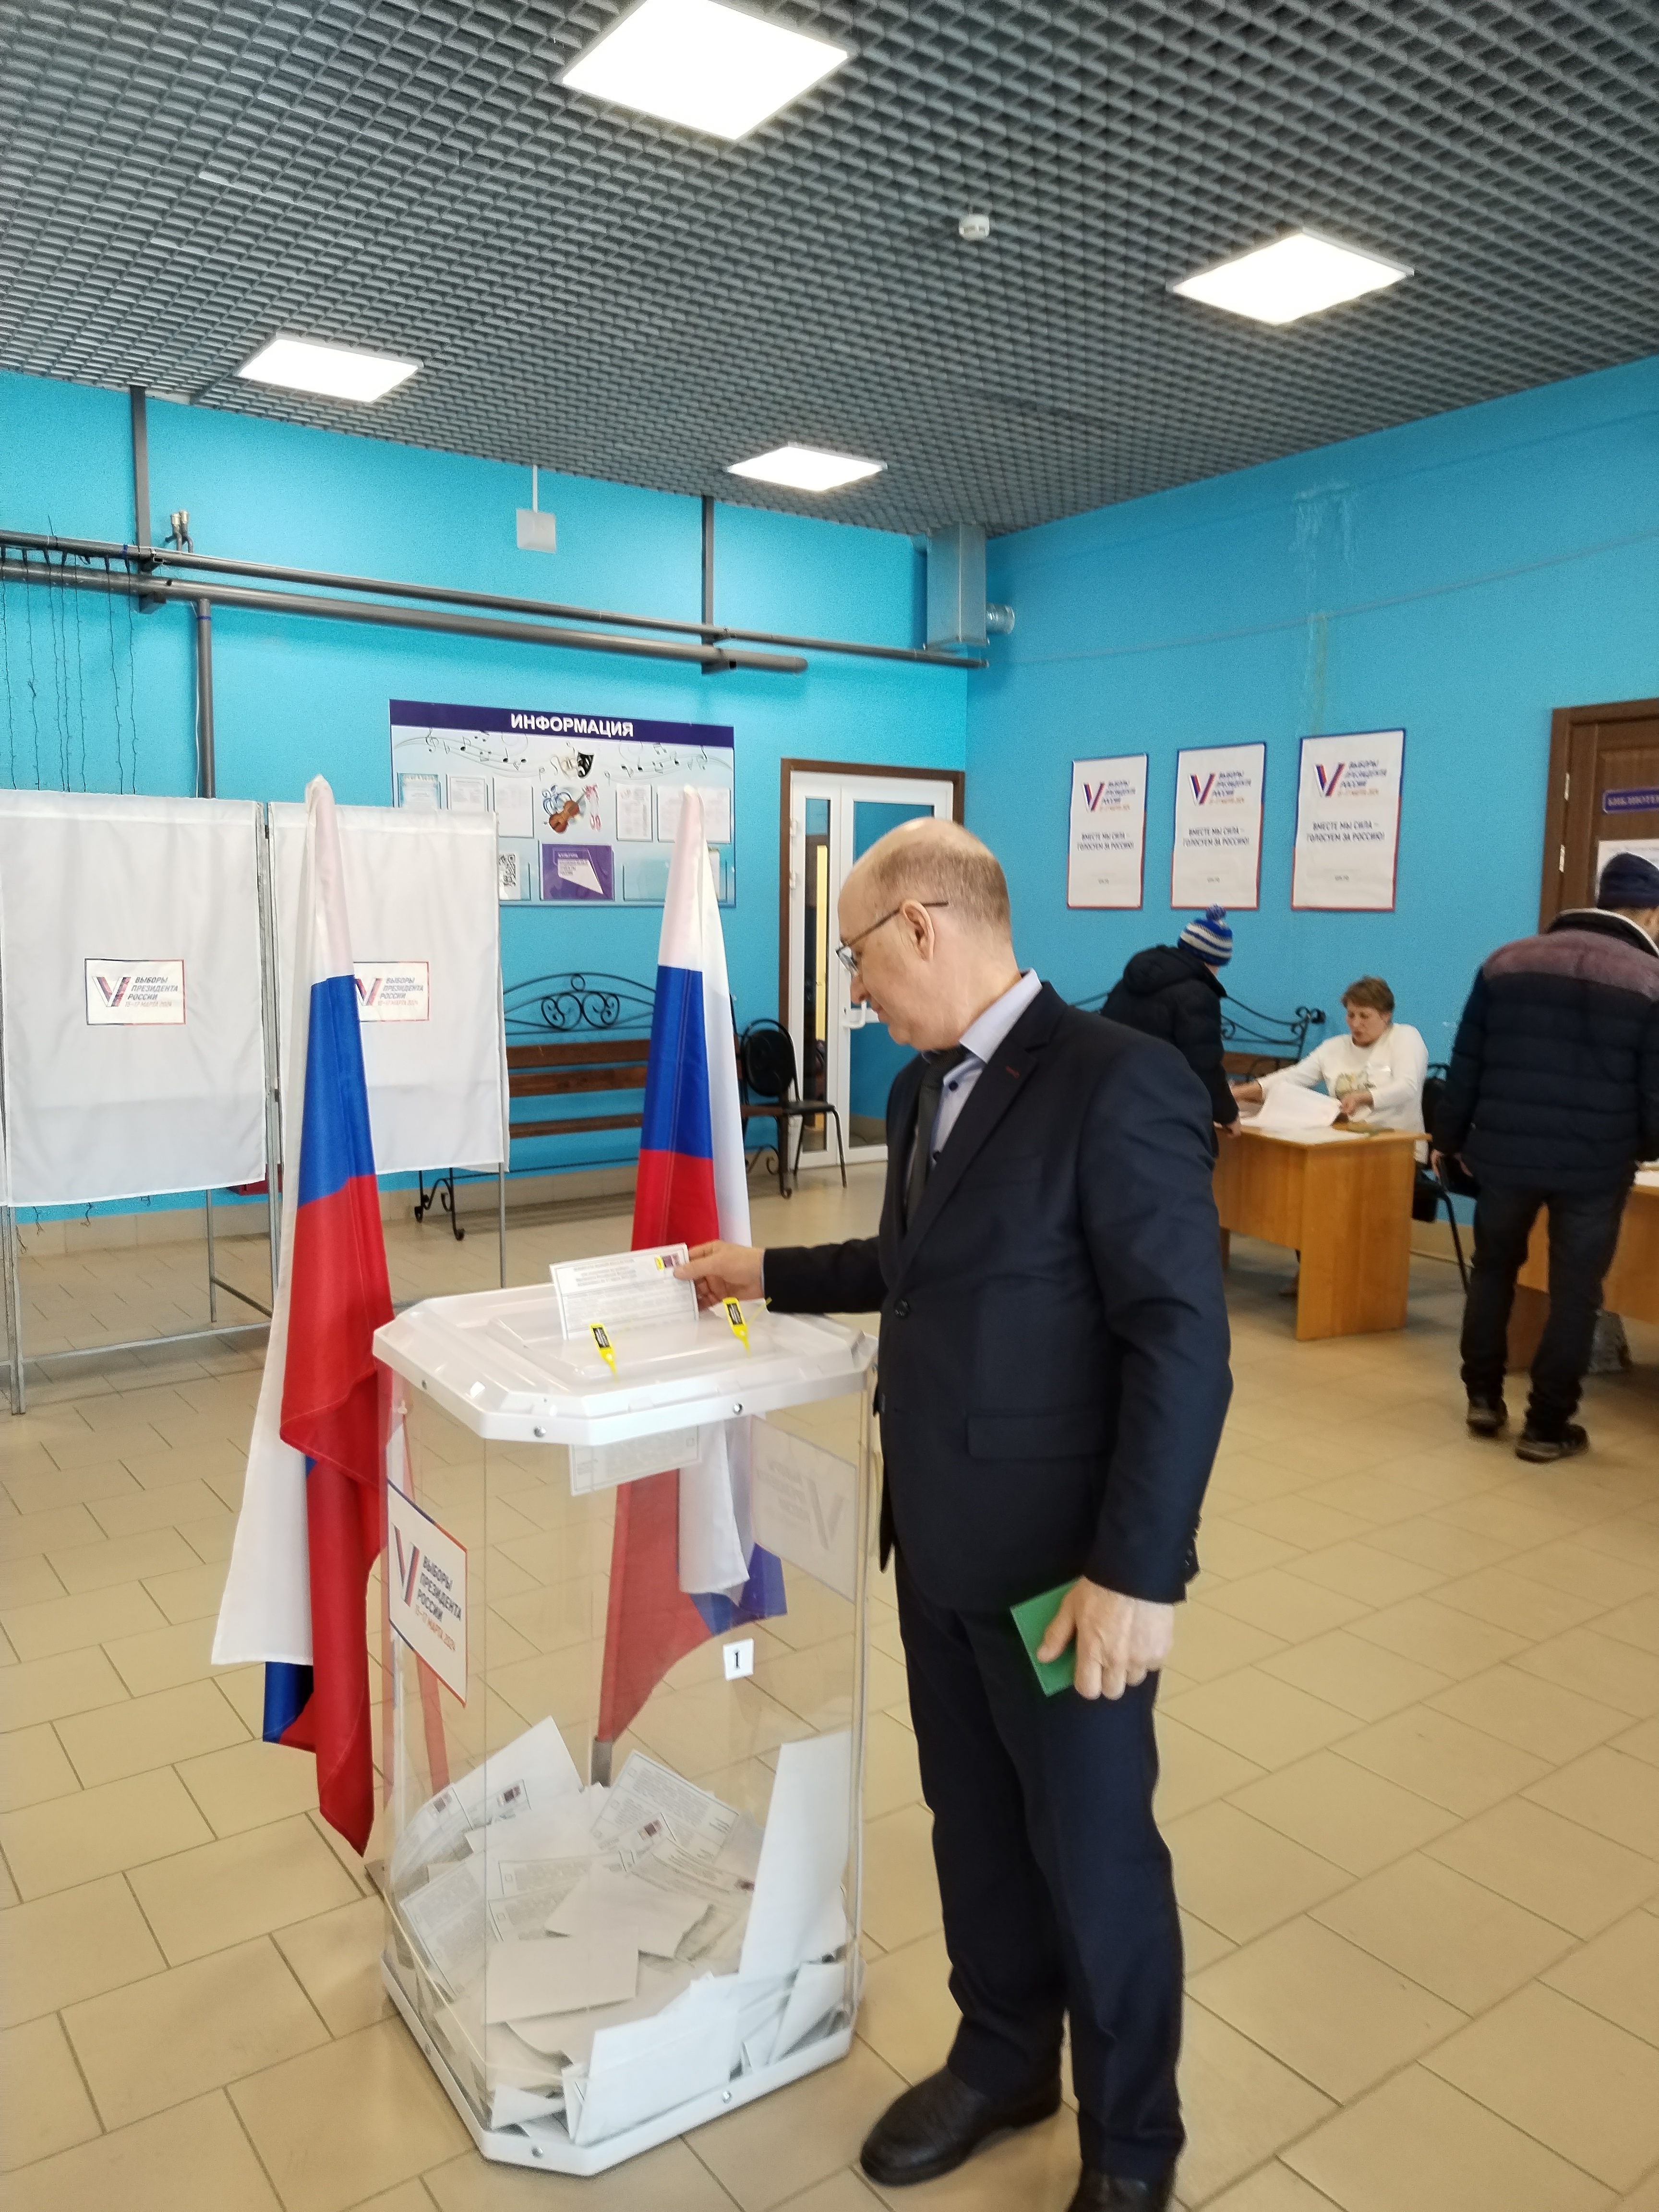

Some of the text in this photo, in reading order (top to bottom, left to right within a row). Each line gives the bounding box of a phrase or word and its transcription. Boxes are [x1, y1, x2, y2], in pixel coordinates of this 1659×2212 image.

[511, 713, 633, 737] ИНФОРМАЦИЯ
[423, 1555, 453, 1591] ВЫБОРЫ
[417, 1587, 443, 1623] РОССИИ
[420, 1572, 462, 1622] ПРЕЗИДЕНТА
[732, 1648, 741, 1670] 1
